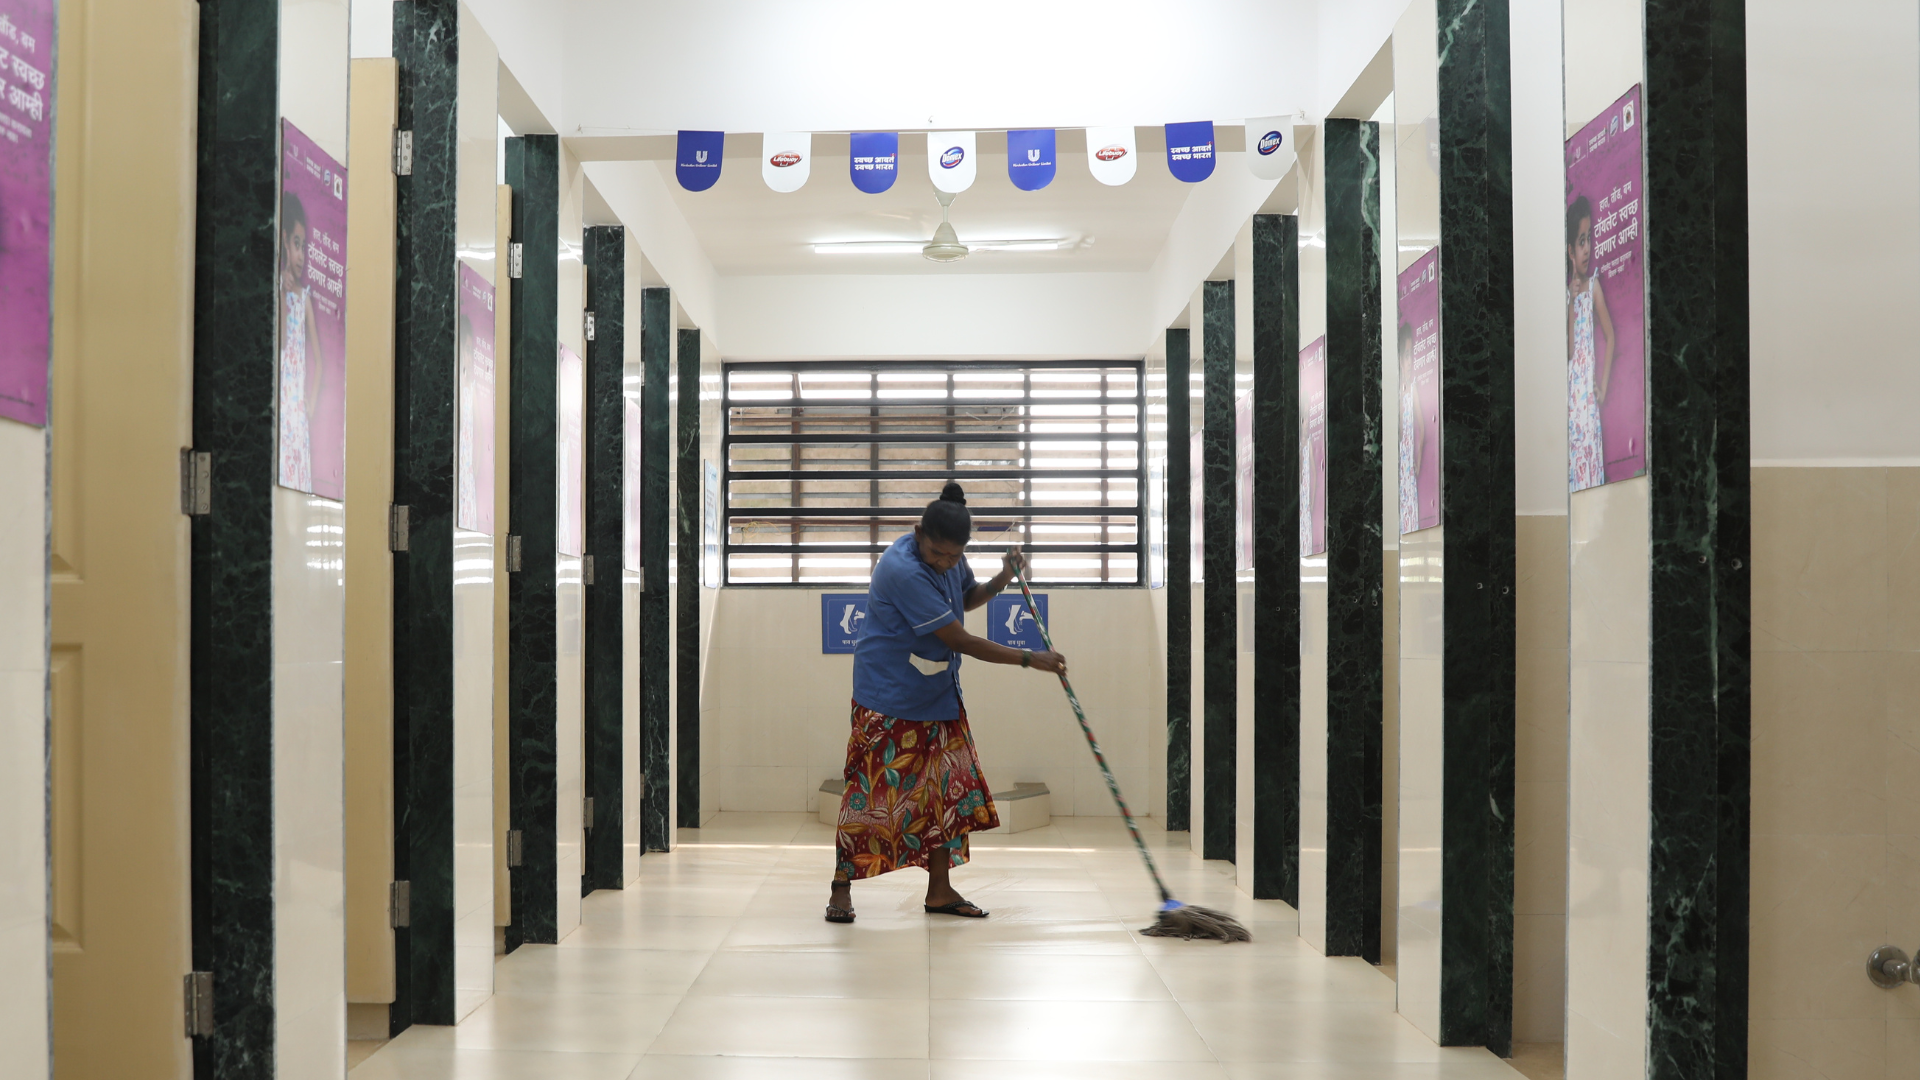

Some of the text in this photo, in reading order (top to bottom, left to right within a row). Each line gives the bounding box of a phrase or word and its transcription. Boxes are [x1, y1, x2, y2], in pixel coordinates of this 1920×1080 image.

[11, 54, 45, 90] स्वच्छ
[9, 85, 43, 122] आम्ही
[1171, 152, 1211, 161] स्वच्छ भारत
[1594, 198, 1639, 238] टॉयलेट स्वच्छ
[1594, 216, 1638, 259] ठेवणार आम्ही
[308, 241, 344, 277] टॉयलेट स्वच्छ
[308, 259, 343, 298] ठेवणार आम्ही
